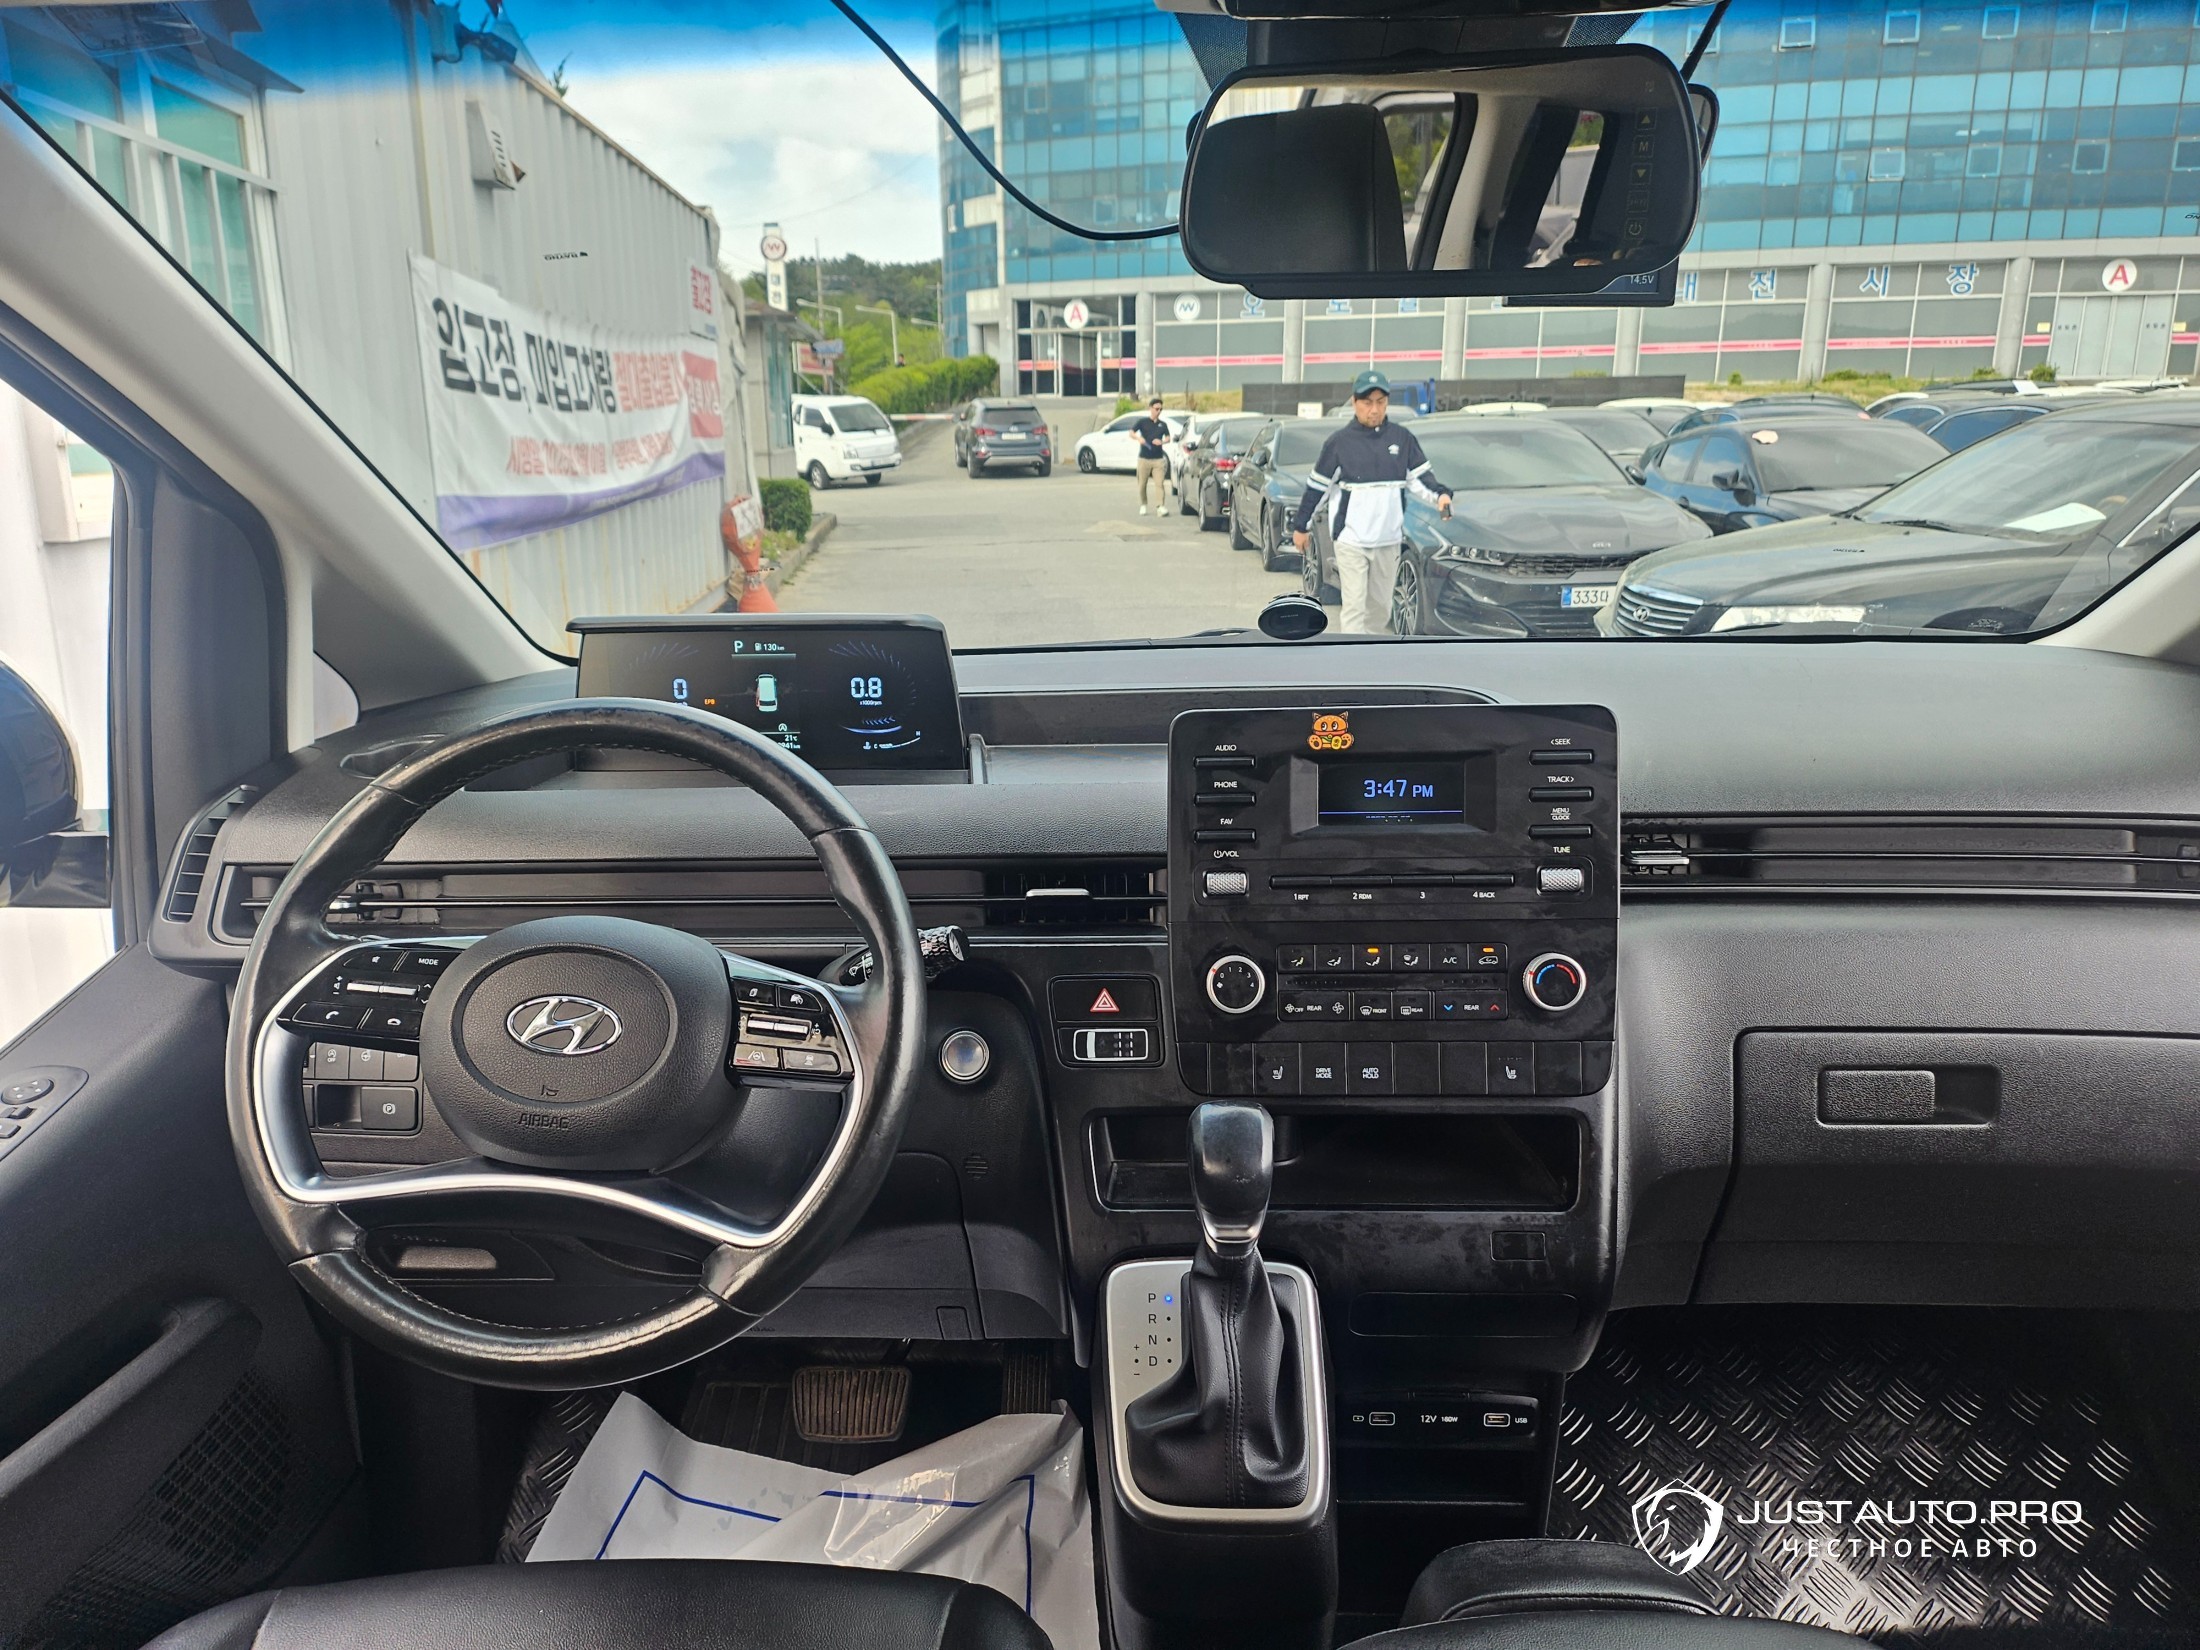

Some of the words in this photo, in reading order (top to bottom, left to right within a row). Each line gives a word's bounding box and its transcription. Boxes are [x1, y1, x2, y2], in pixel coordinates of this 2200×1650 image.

[1630, 274, 1655, 285] 14.5V
[2109, 264, 2129, 285] A
[1068, 302, 1084, 323] A
[734, 640, 744, 653] P
[673, 678, 688, 700] 0
[850, 677, 882, 698] 0.8
[1214, 744, 1237, 752] AUDIO
[1363, 779, 1407, 798] 3:47
[1412, 784, 1434, 798] PM
[418, 957, 439, 966] MODE
[1442, 956, 1458, 964] A/C
[519, 1112, 570, 1130] AIRBAG
[1148, 1293, 1157, 1304] P
[1148, 1313, 1157, 1324] R
[1148, 1334, 1157, 1345] N
[1148, 1355, 1158, 1367] D
[1420, 1415, 1438, 1423] 12V
